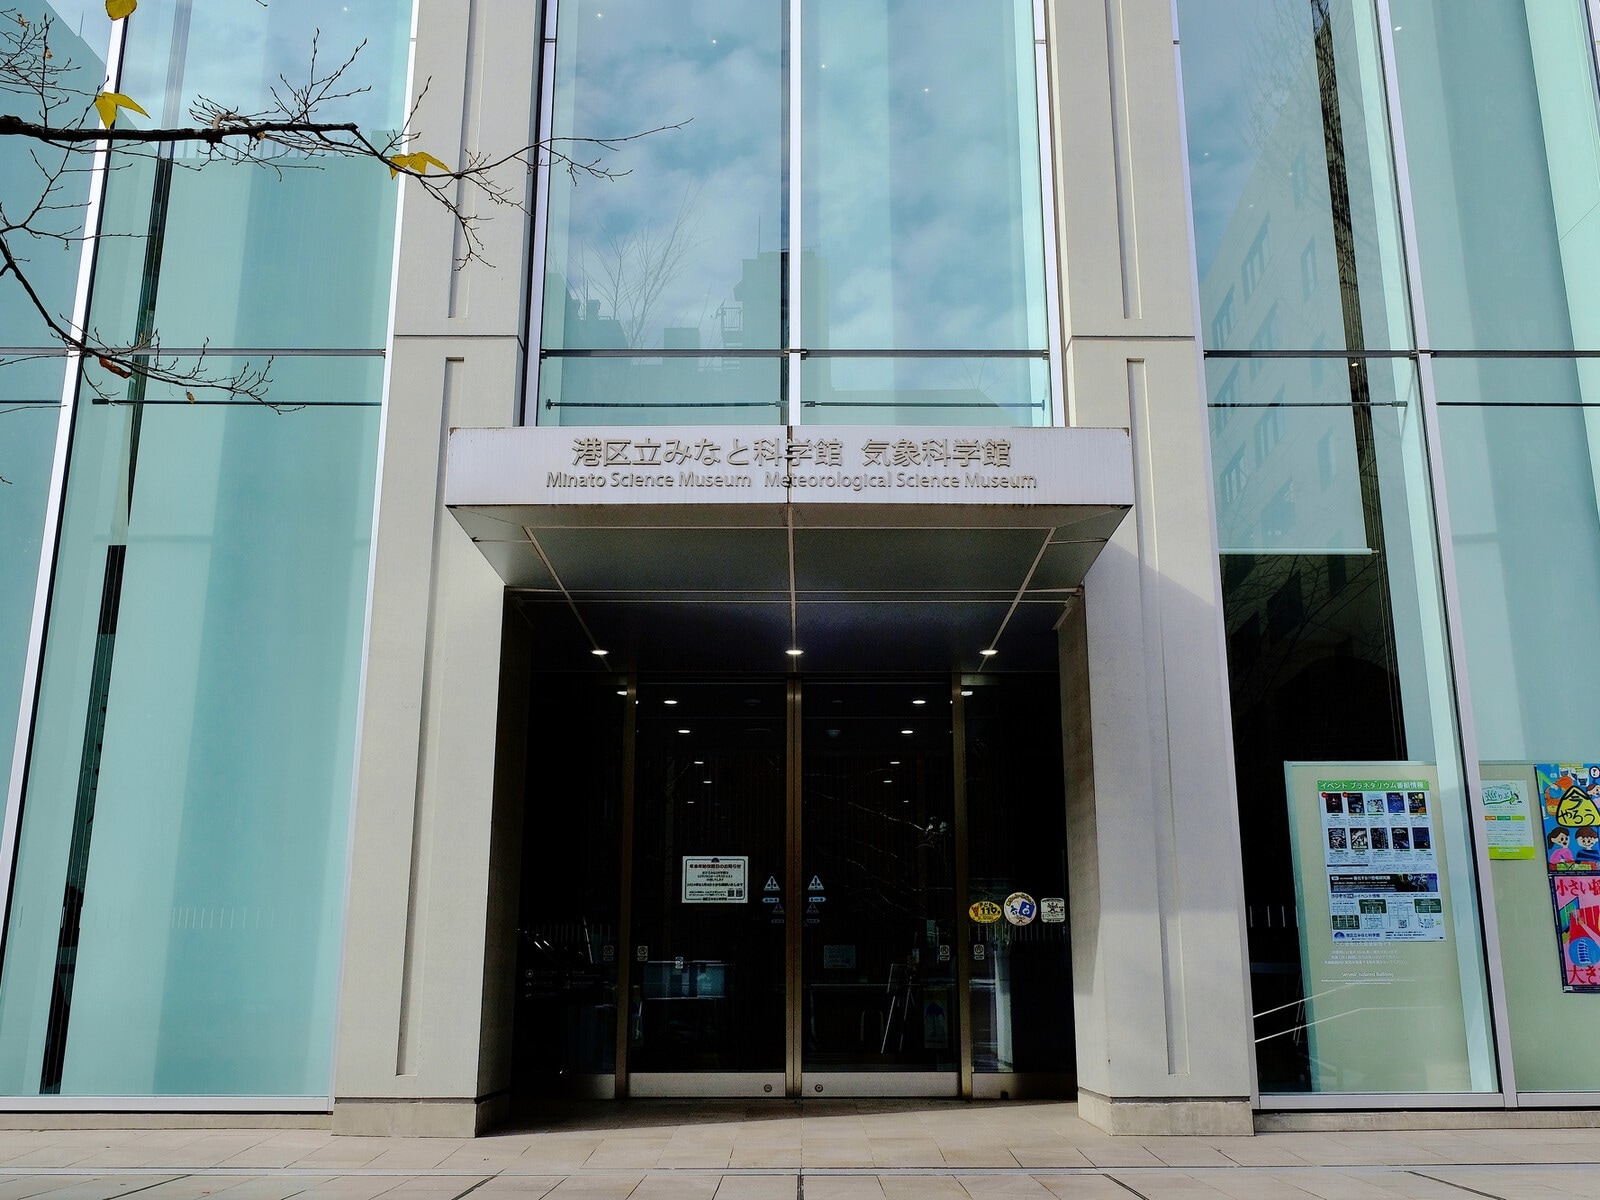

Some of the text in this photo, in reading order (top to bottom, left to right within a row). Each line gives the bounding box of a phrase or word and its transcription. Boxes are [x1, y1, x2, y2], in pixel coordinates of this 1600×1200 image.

[572, 438, 1011, 467] 港区立みなと科学館 気象科学館
[547, 471, 1037, 491] Minato Science Museum Meteorological Science Museum
[1320, 782, 1348, 790] イベント
[1558, 808, 1596, 825] やろう
[1566, 964, 1600, 986] 大き
